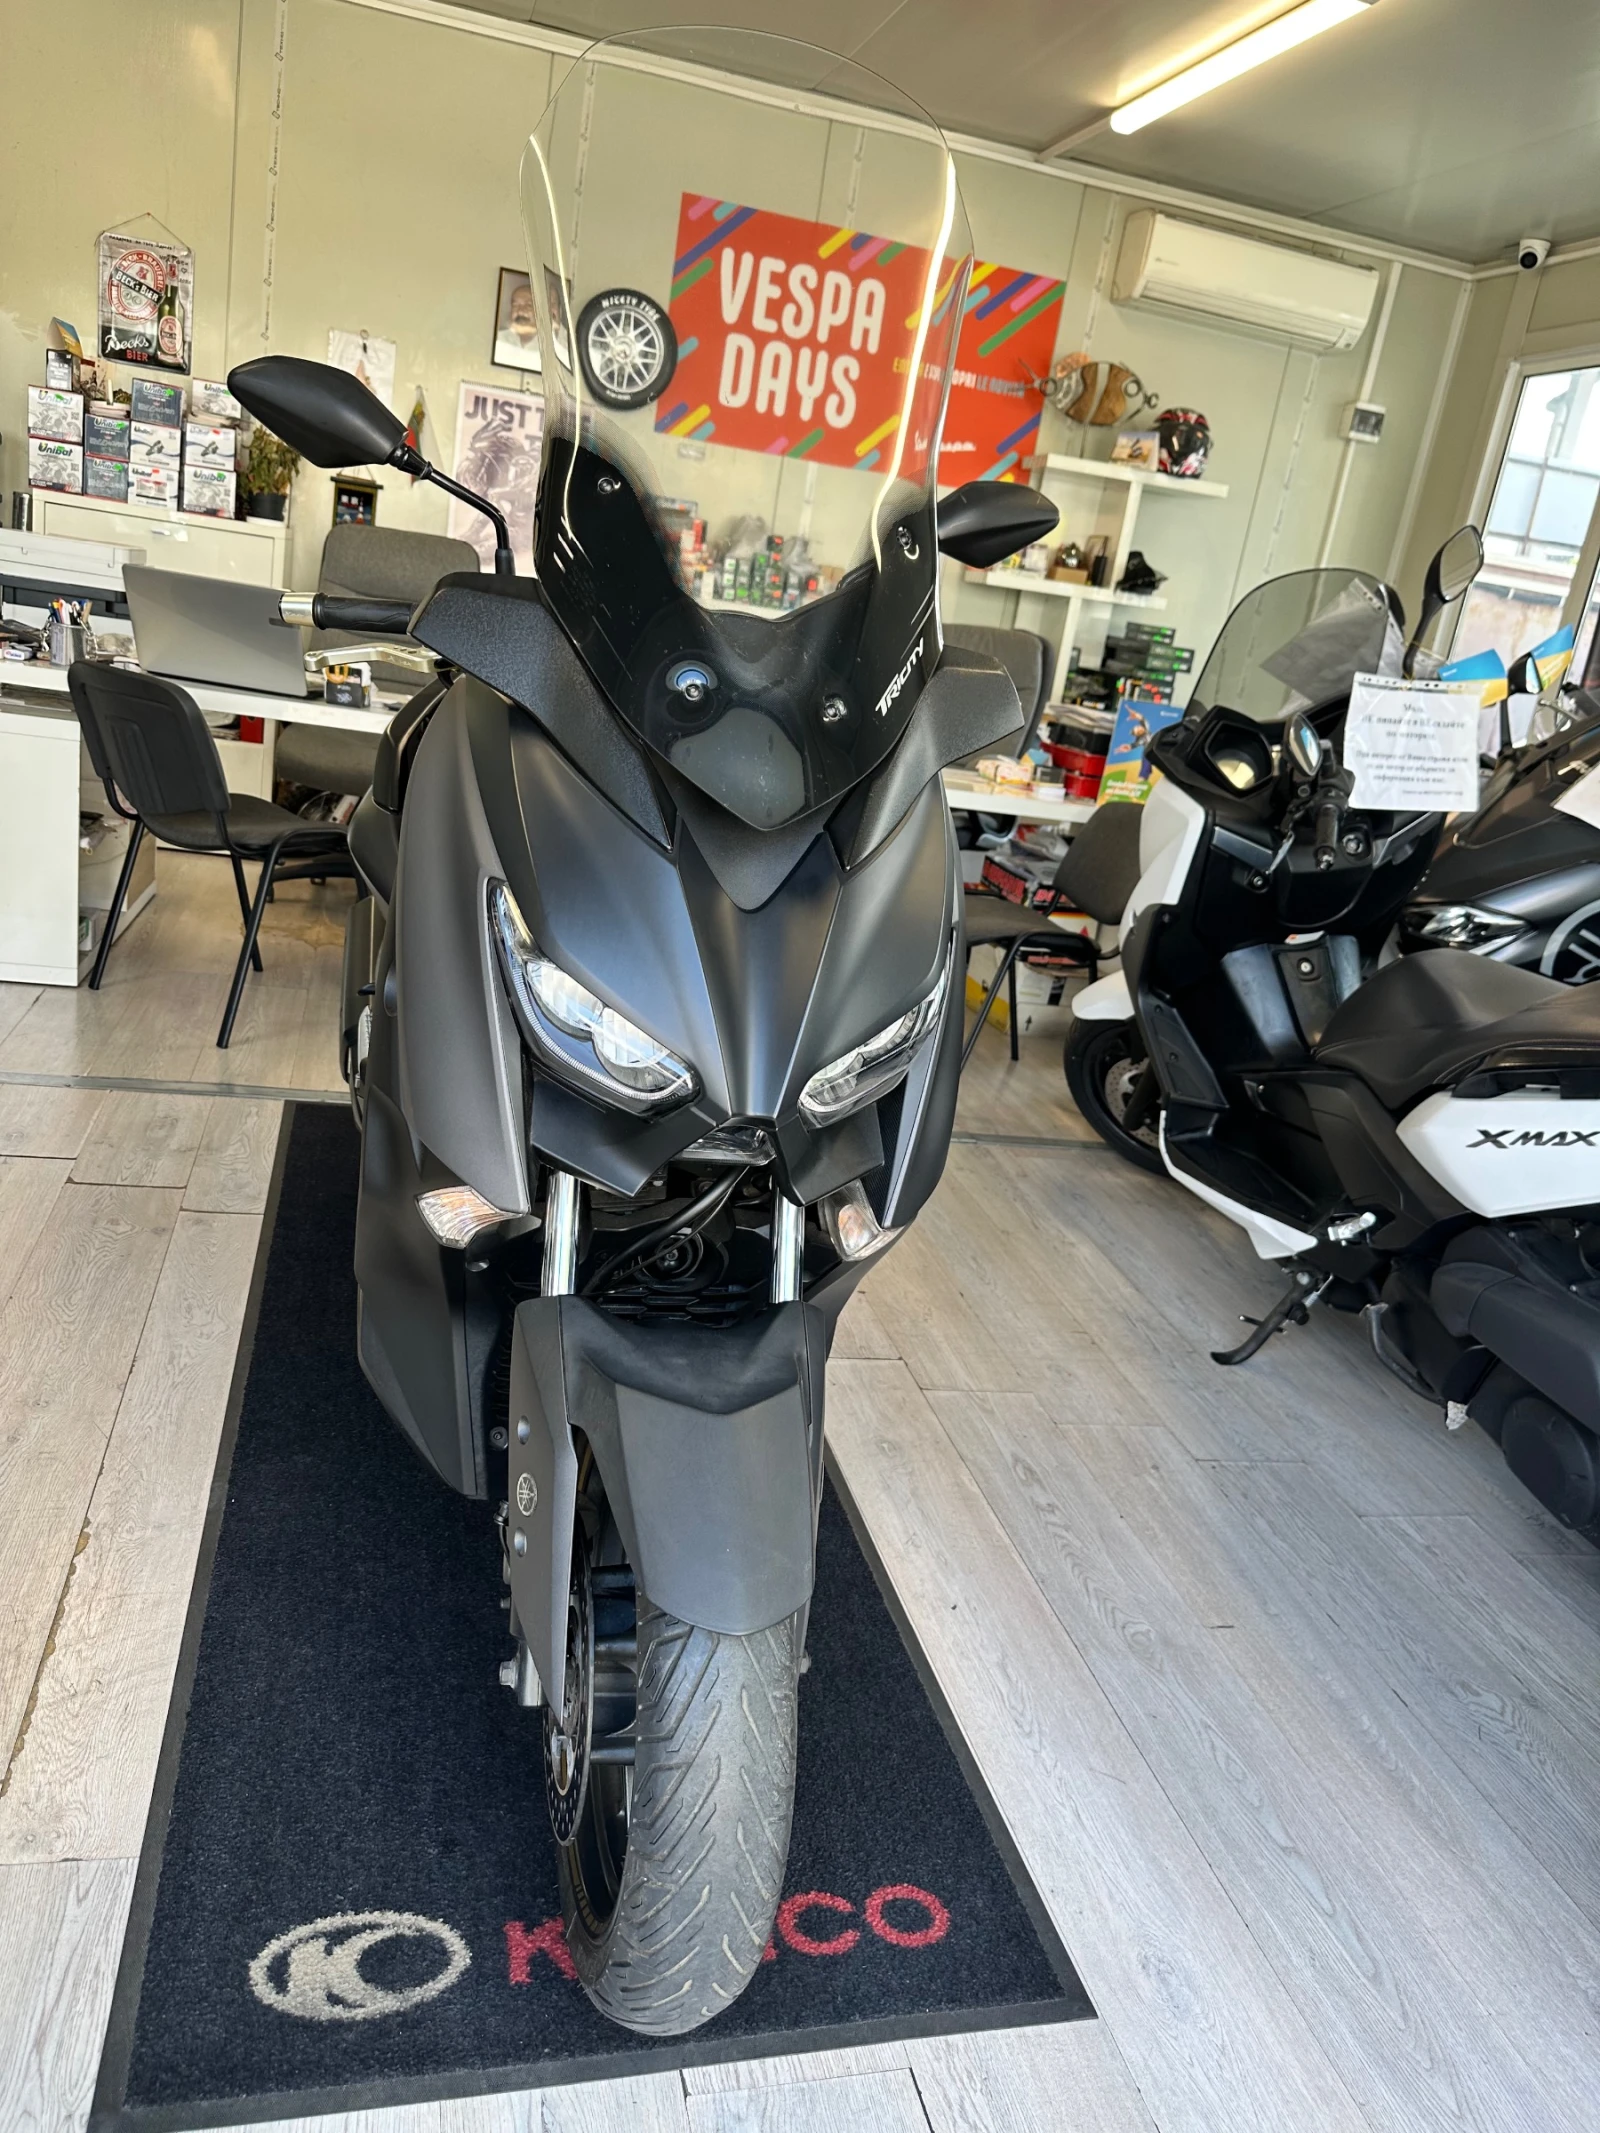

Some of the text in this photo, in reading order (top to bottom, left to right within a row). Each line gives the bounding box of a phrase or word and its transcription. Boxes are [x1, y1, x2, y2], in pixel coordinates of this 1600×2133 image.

[140, 284, 159, 302] BIER
[719, 246, 887, 354] VESPA
[125, 349, 149, 362] BIER
[718, 332, 861, 429] DAYS
[464, 395, 532, 429] JUST
[875, 637, 924, 717] TRICITY
[1465, 1128, 1600, 1149] XMAX
[506, 1882, 951, 1986] KCO
